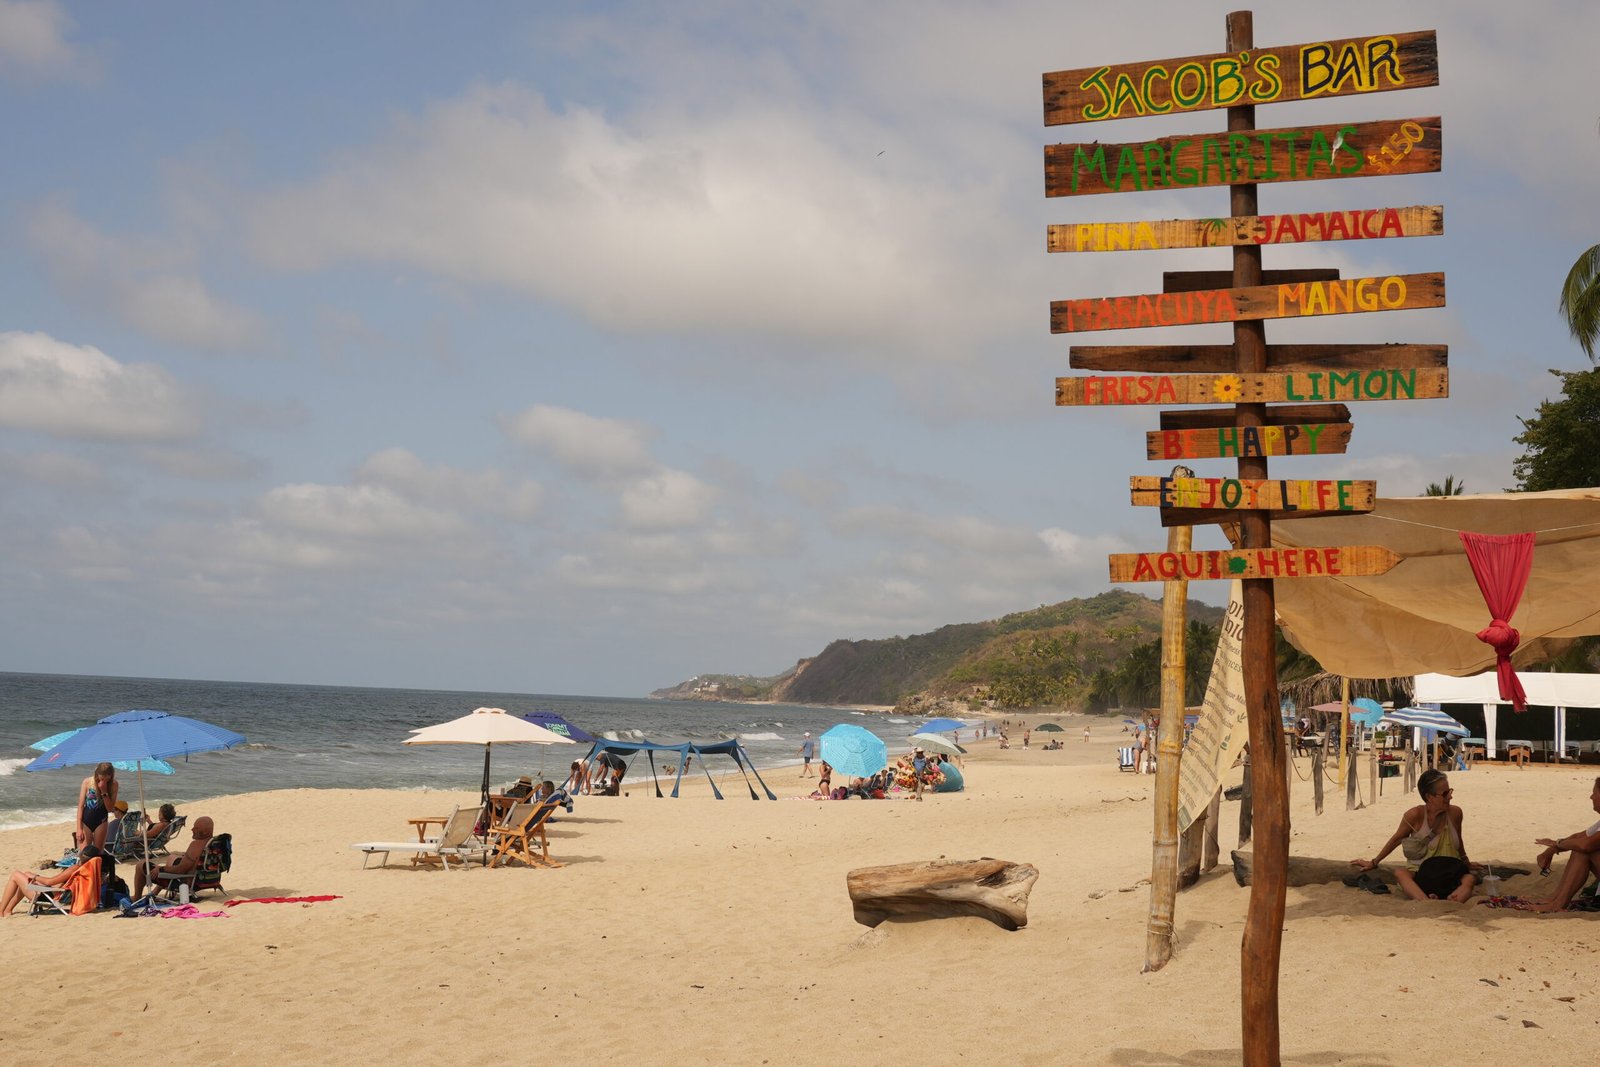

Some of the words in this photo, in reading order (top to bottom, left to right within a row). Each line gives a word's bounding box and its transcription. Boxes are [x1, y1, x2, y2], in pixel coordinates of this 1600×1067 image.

[1080, 53, 1281, 120] JACOB'S
[1300, 35, 1404, 99] BAR
[1071, 125, 1364, 193] MARGARITAS
[1367, 121, 1424, 173] $150
[1253, 207, 1403, 245] JAMAICA
[1066, 289, 1237, 332] MARACUYA
[1278, 276, 1407, 317] MANGO
[1084, 375, 1176, 404] FRESA
[1286, 368, 1416, 401] LIMON
[1163, 429, 1198, 460] BE
[1218, 424, 1325, 458] HAPPY
[1160, 477, 1266, 509] ENJOY
[1281, 479, 1354, 512] LIFE
[1133, 551, 1222, 581] AQUI
[1257, 548, 1342, 577] HERE
